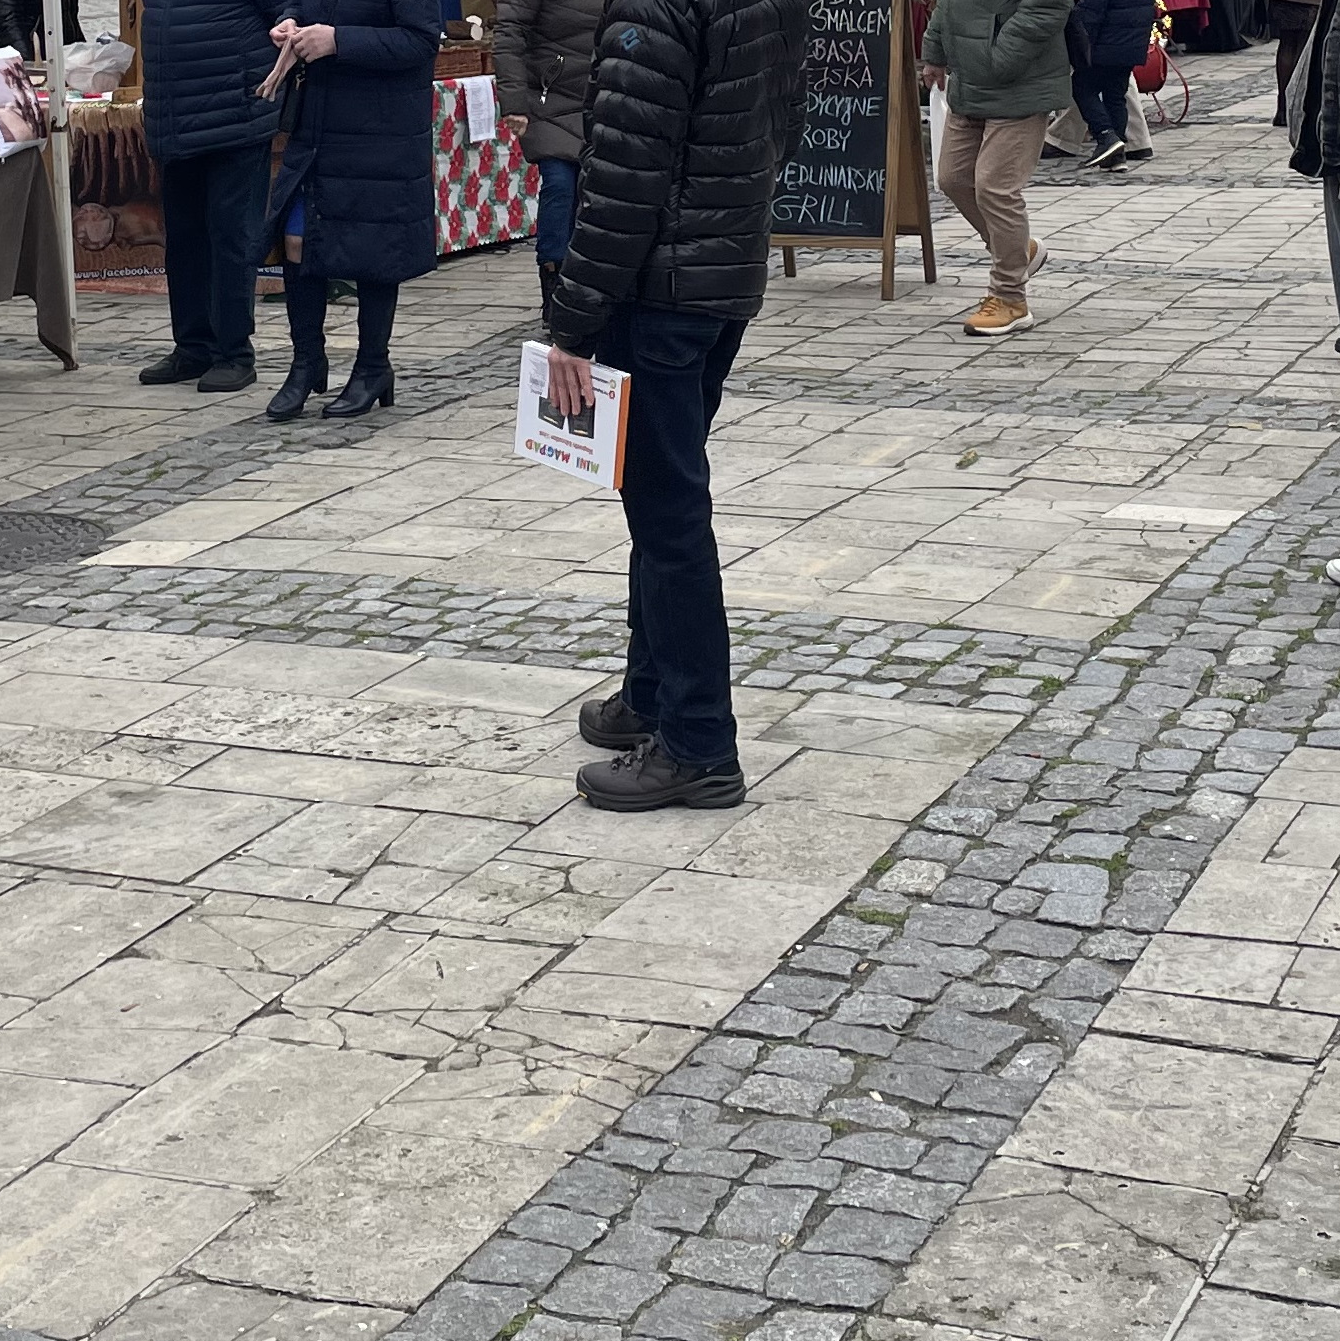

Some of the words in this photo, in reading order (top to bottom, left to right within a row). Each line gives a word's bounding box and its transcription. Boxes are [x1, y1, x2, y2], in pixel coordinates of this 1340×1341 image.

[811, 8, 892, 36] SMALCEM
[771, 193, 863, 225] GRILL
[525, 439, 571, 464] MAGPAD
[576, 456, 600, 475] MINI
